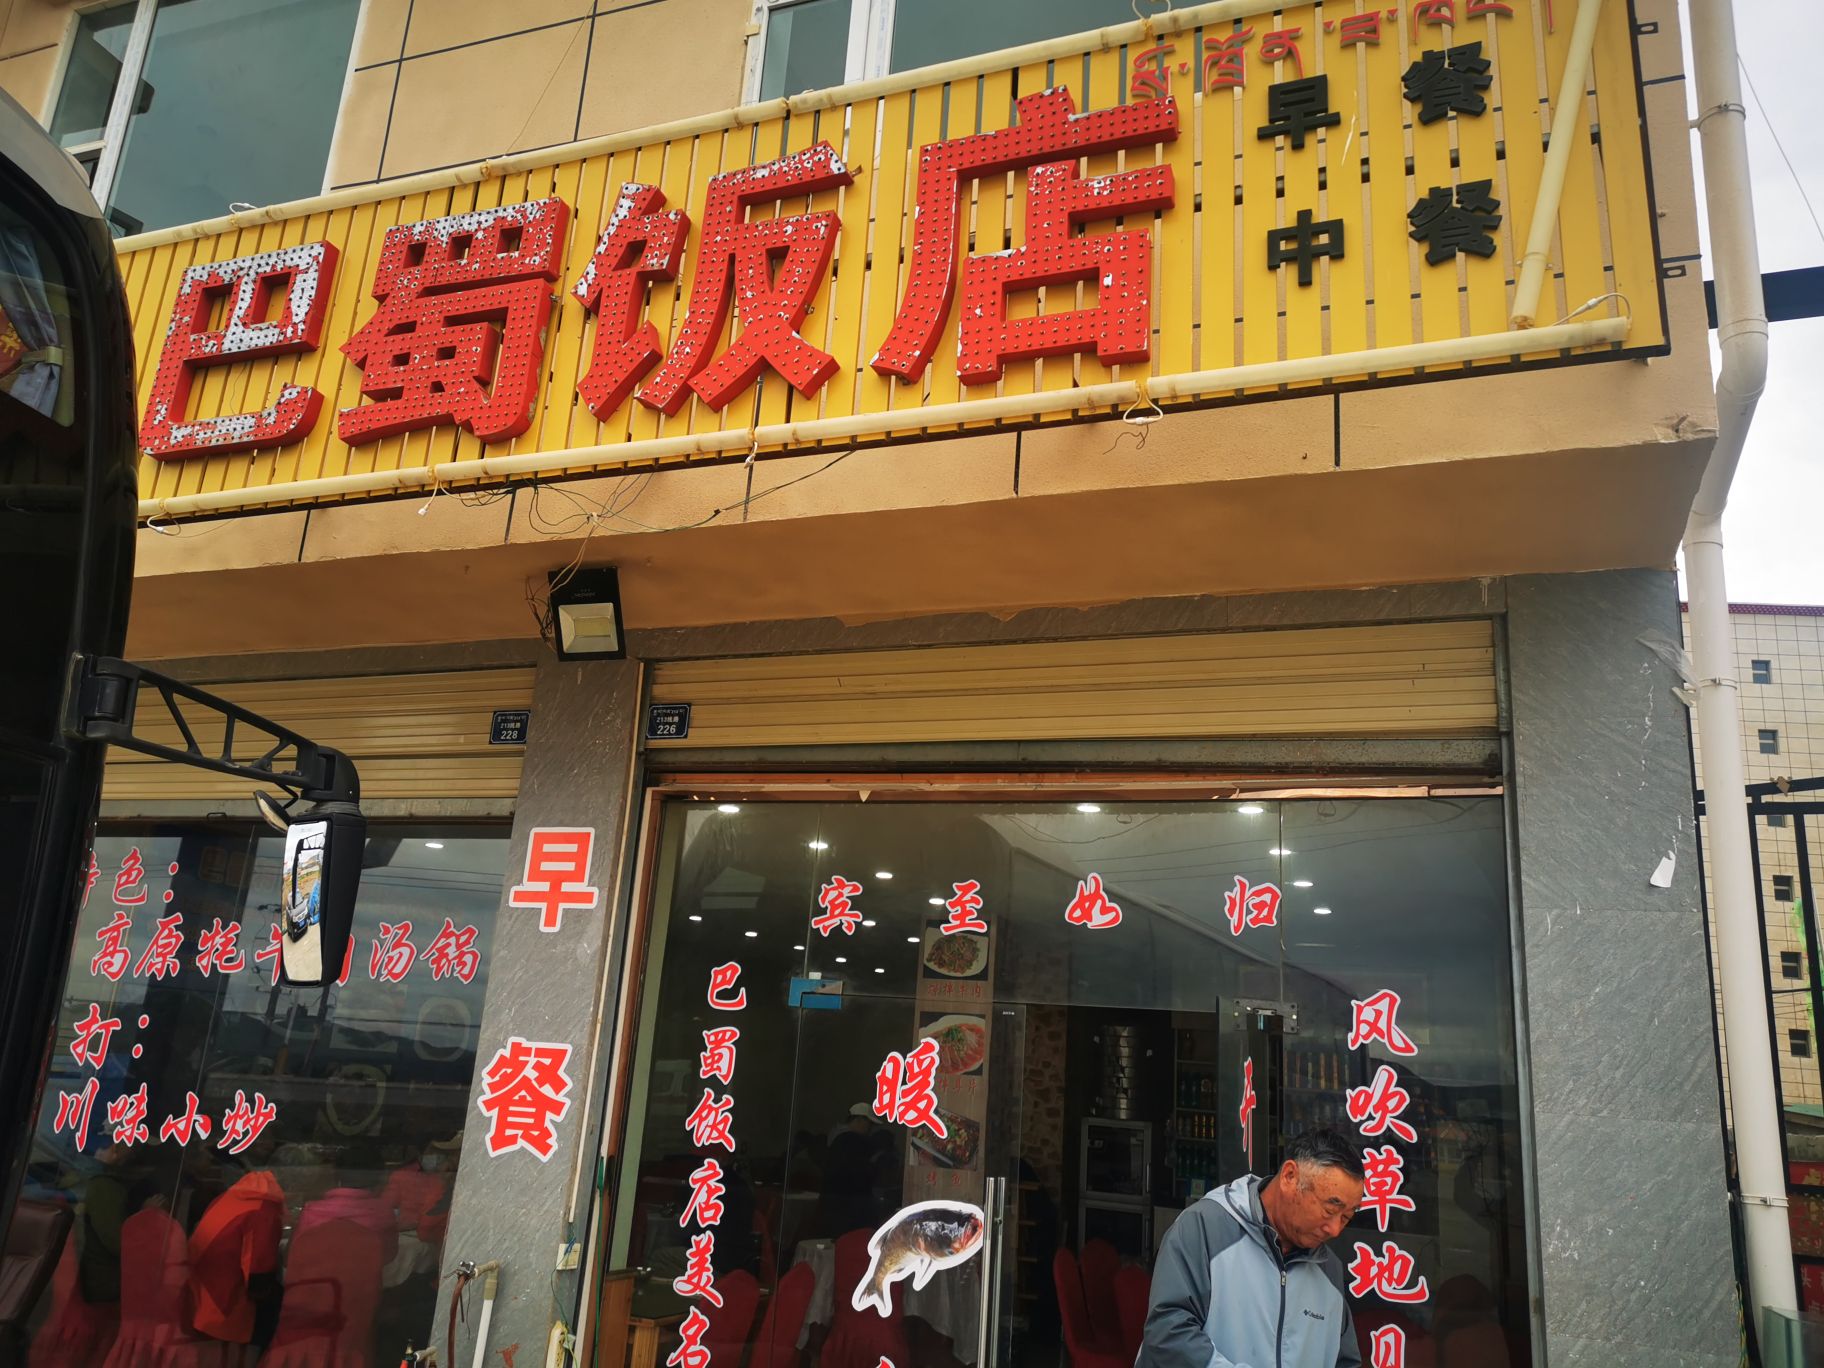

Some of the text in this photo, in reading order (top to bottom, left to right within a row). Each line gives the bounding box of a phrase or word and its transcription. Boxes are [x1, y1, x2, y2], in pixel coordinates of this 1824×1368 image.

[1257, 41, 1492, 150] 早餐
[139, 84, 1179, 463] 巴蜀饭店
[1267, 179, 1502, 286] 中餐
[500, 730, 518, 740] 228
[657, 725, 677, 735] 226
[90, 911, 483, 988] 高原牦汤锅
[811, 872, 1283, 938] 宾至如归
[478, 826, 598, 1163] 早餐
[53, 1076, 278, 1155] 川味小炒
[873, 1037, 948, 1139] 暖
[667, 962, 747, 1368] 巴蜀饭店美名
